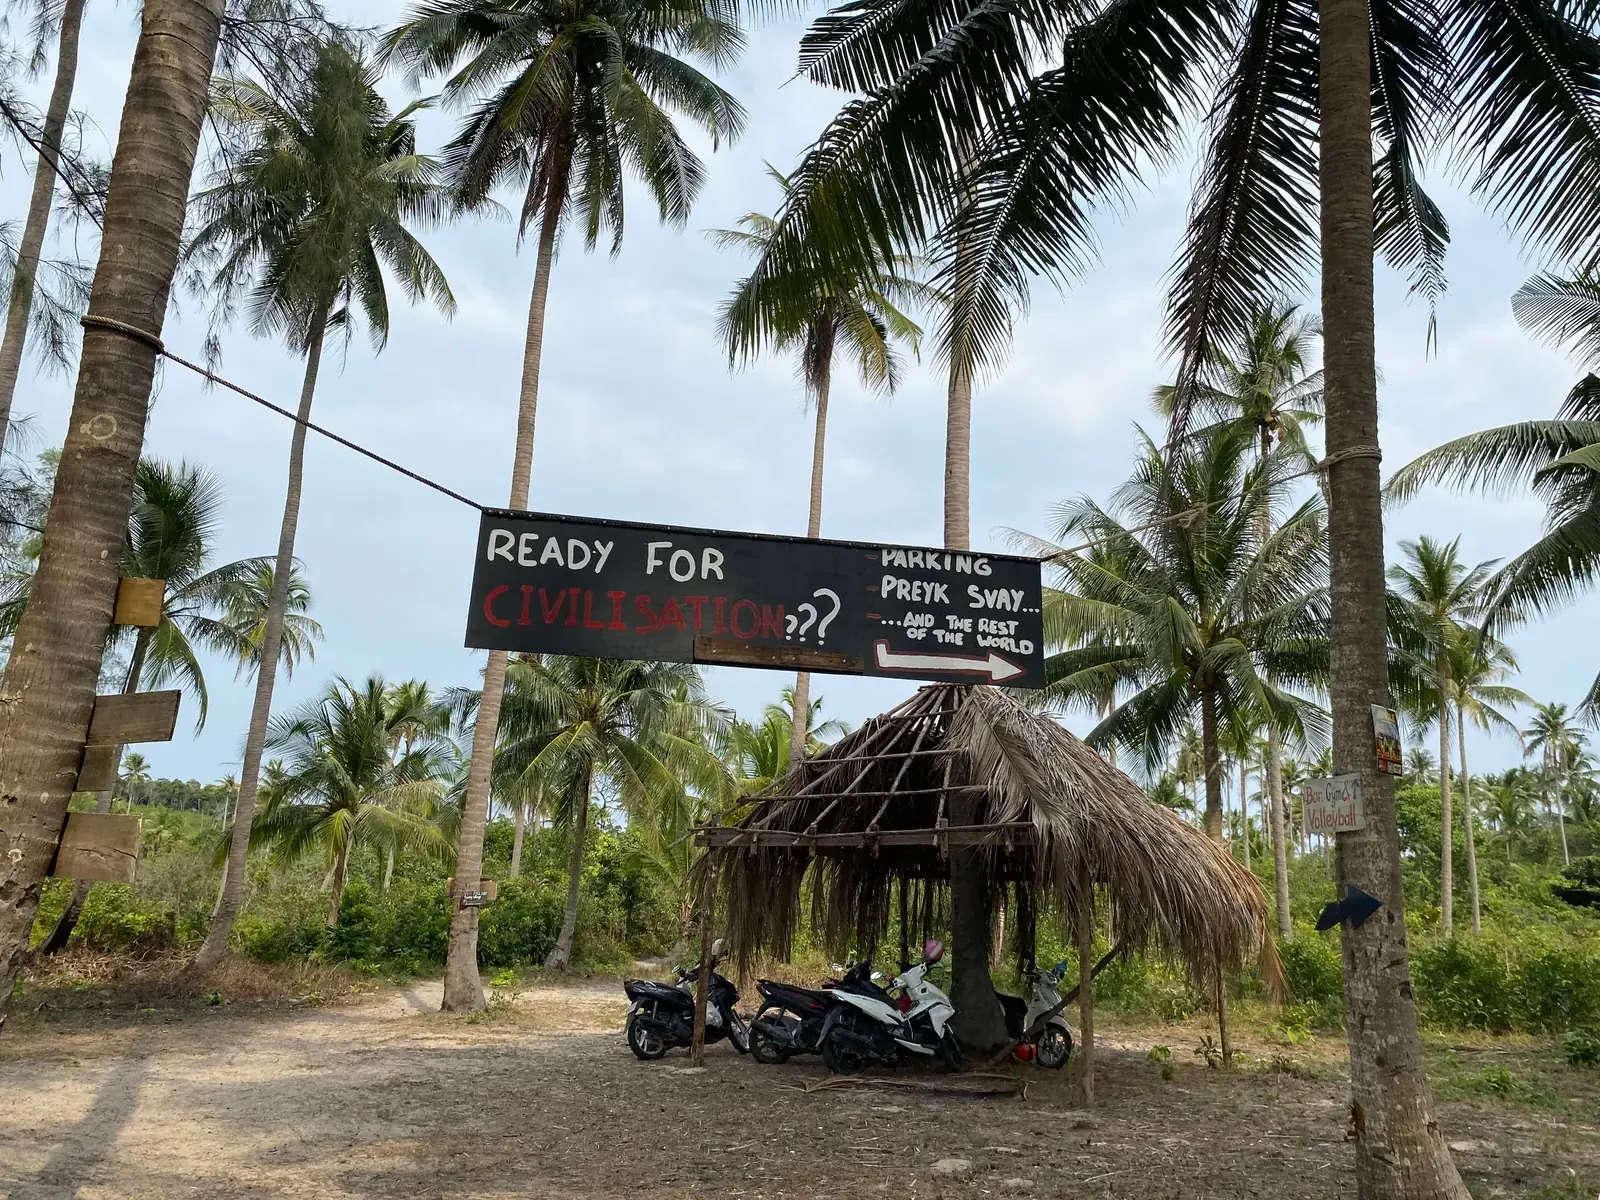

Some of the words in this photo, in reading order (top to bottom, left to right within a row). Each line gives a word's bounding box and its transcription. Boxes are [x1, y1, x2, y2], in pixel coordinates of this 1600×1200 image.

[487, 528, 614, 574] READY
[646, 540, 725, 583] FOR
[881, 548, 993, 577] PARKING
[881, 574, 950, 605] PREYK
[967, 584, 1040, 614] SVAY...
[946, 614, 973, 633] THE
[978, 617, 1019, 636] REST
[906, 628, 927, 641] OF
[932, 629, 964, 646] THE
[976, 633, 1034, 655] WORLD
